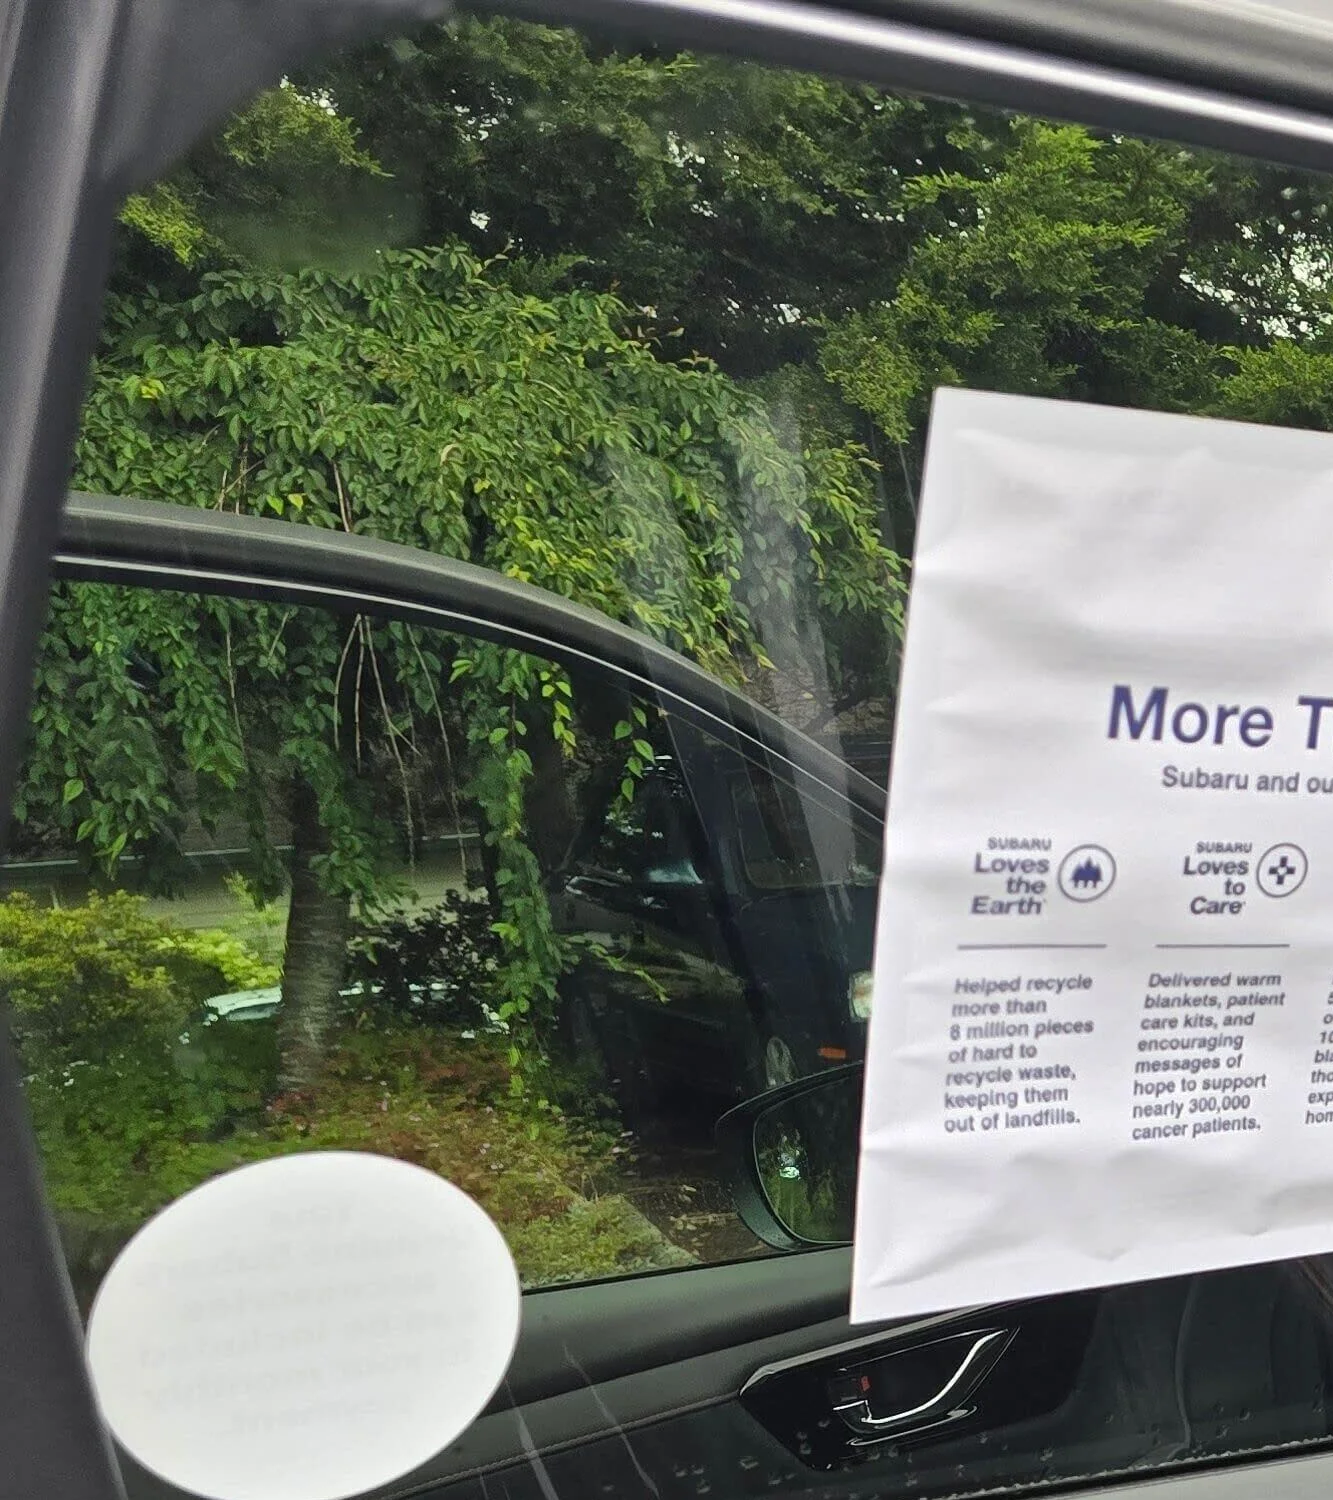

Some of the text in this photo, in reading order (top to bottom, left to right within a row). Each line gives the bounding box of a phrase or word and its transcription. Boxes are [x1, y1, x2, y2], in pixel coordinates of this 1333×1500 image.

[1107, 685, 1274, 748] More
[1161, 765, 1249, 790] Subaru
[1255, 772, 1300, 793] and
[989, 837, 1052, 851] SUBARU
[1197, 841, 1253, 854] SUBARU
[975, 852, 1049, 874] Loves
[1184, 856, 1249, 876] Loves
[1008, 877, 1046, 895] the
[1225, 878, 1246, 896] to
[971, 895, 1042, 915] Earth
[1190, 896, 1243, 915] Care
[953, 974, 1093, 996] Helped recycle
[1148, 972, 1281, 988] Delivered warm
[952, 999, 1047, 1017] more than
[1144, 992, 1286, 1009] blankets, patient
[950, 1019, 1094, 1041] 8 million pieces
[1140, 1012, 1255, 1030] care kits, and
[1137, 1033, 1244, 1052] encouraging
[948, 1044, 1037, 1064] of hard to
[1135, 1053, 1243, 1074] messages of
[946, 1064, 1076, 1088] recycle waste,
[1133, 1073, 1267, 1098] hope to support
[944, 1087, 1068, 1111] keeping them
[1133, 1095, 1250, 1119] nearly 300,000
[944, 1108, 1080, 1133] out of landfills.
[1132, 1116, 1261, 1140] cancer patients.
